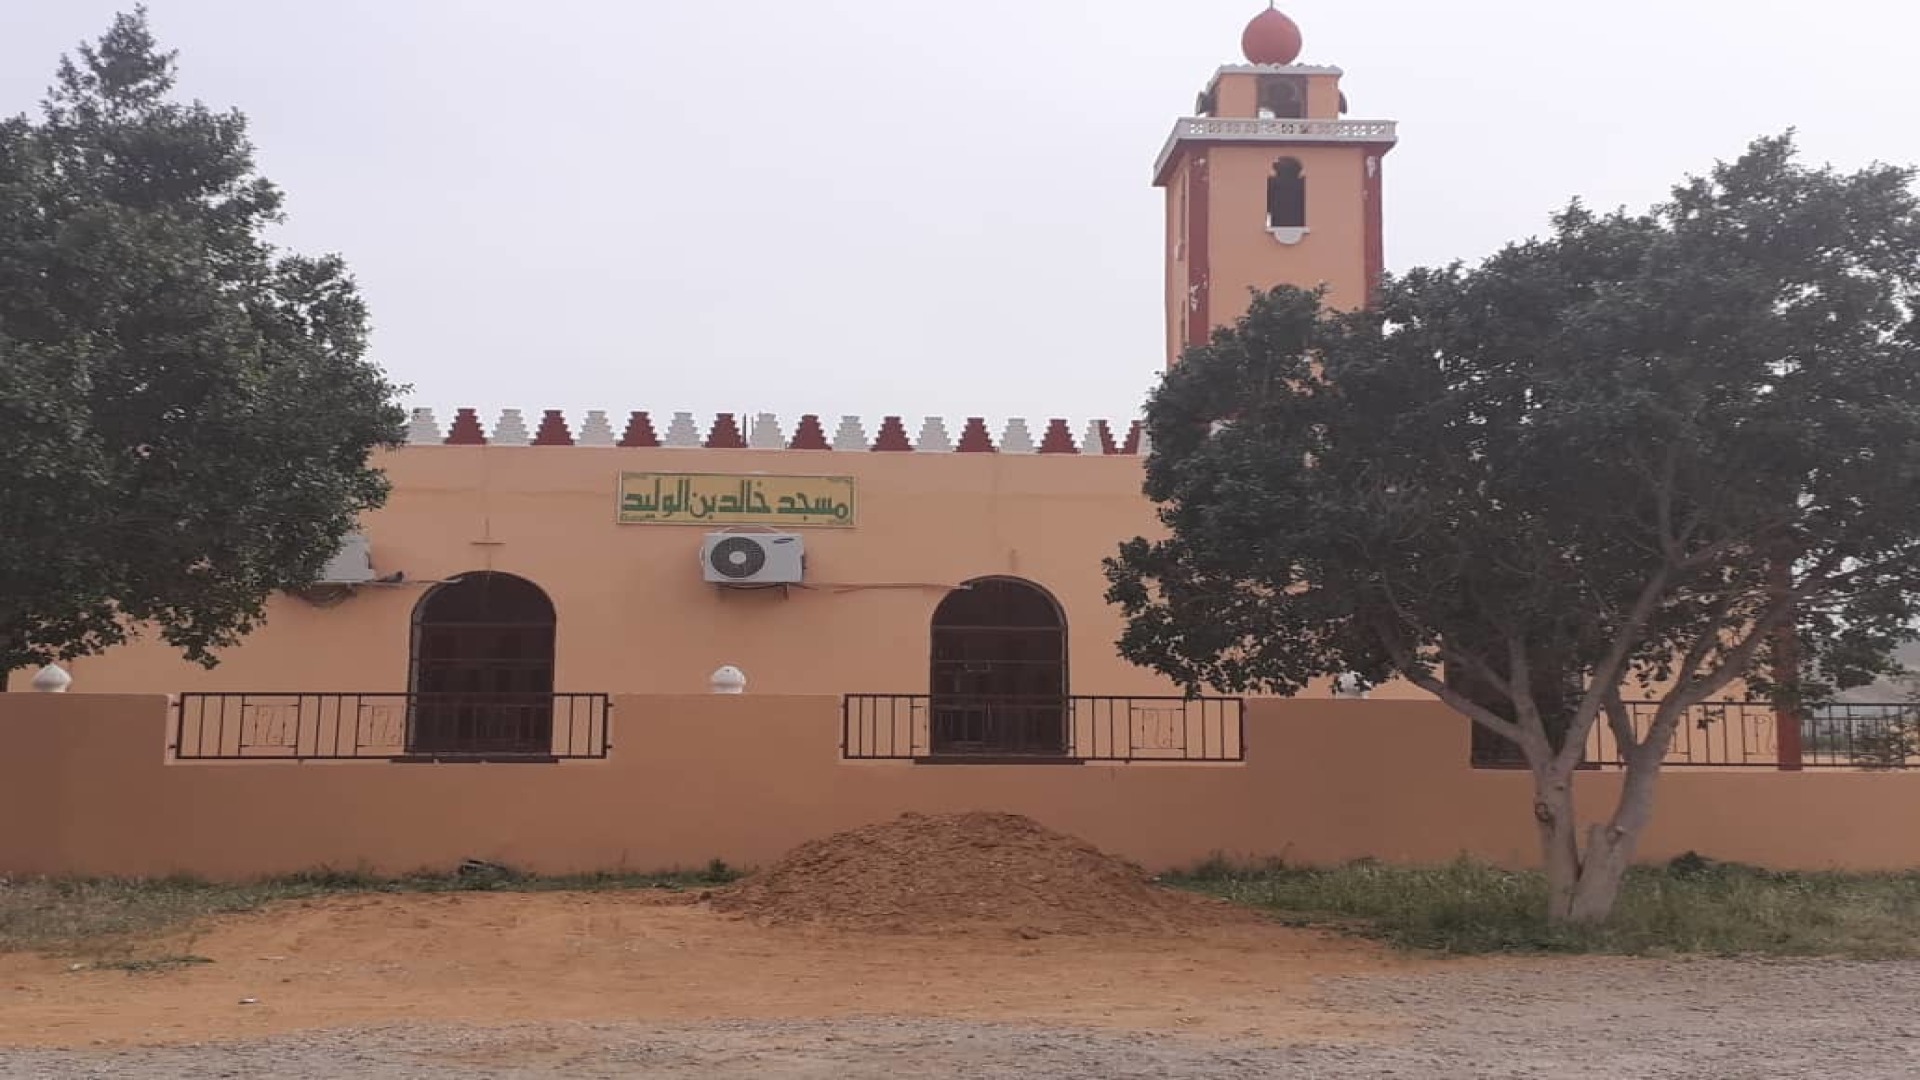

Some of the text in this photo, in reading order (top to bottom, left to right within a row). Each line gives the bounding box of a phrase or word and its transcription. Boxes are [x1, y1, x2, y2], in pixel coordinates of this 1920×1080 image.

[623, 477, 849, 521] مسجد خالد بن الوليد
